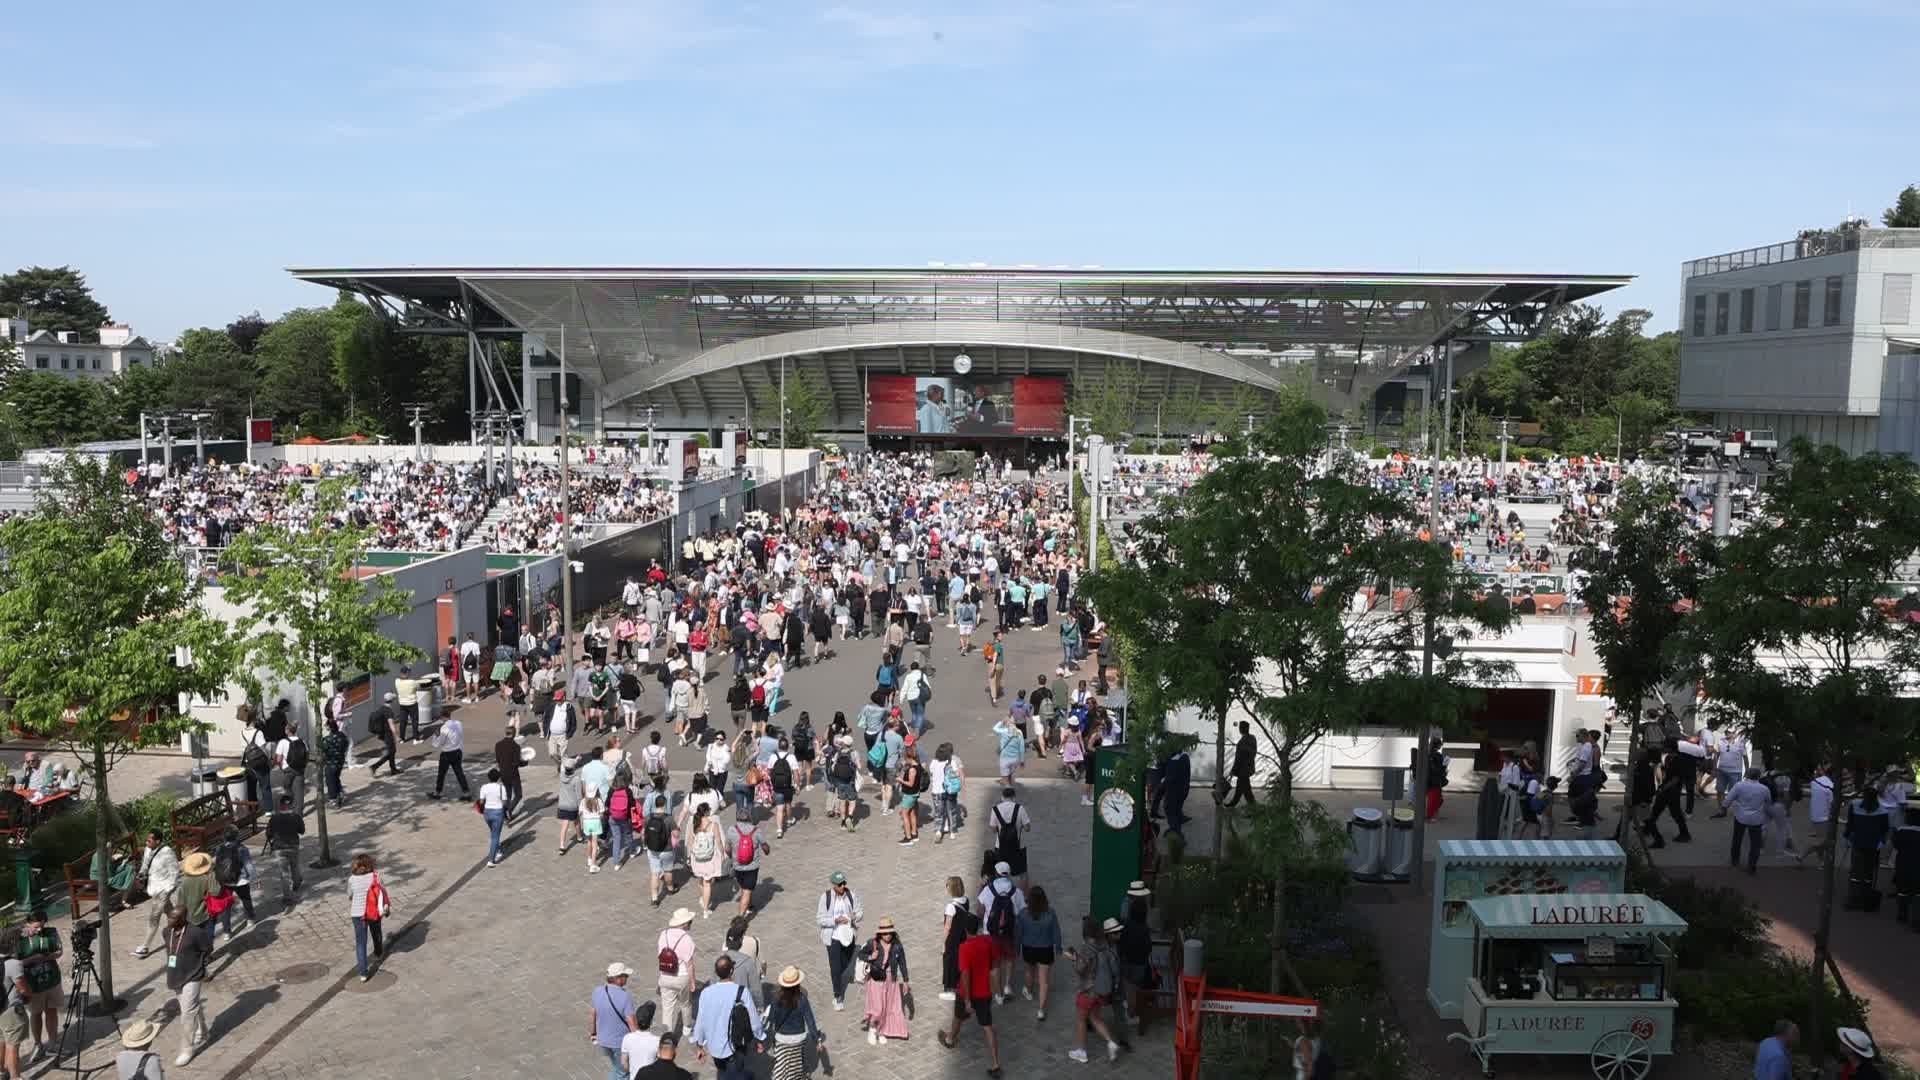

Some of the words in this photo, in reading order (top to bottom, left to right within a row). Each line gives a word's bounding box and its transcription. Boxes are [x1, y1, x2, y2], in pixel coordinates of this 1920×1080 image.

[1590, 677, 1601, 693] 7
[1101, 767, 1137, 783] ROX
[1530, 903, 1646, 925] LADURÉE
[1495, 1015, 1586, 1032] LADURÉE
